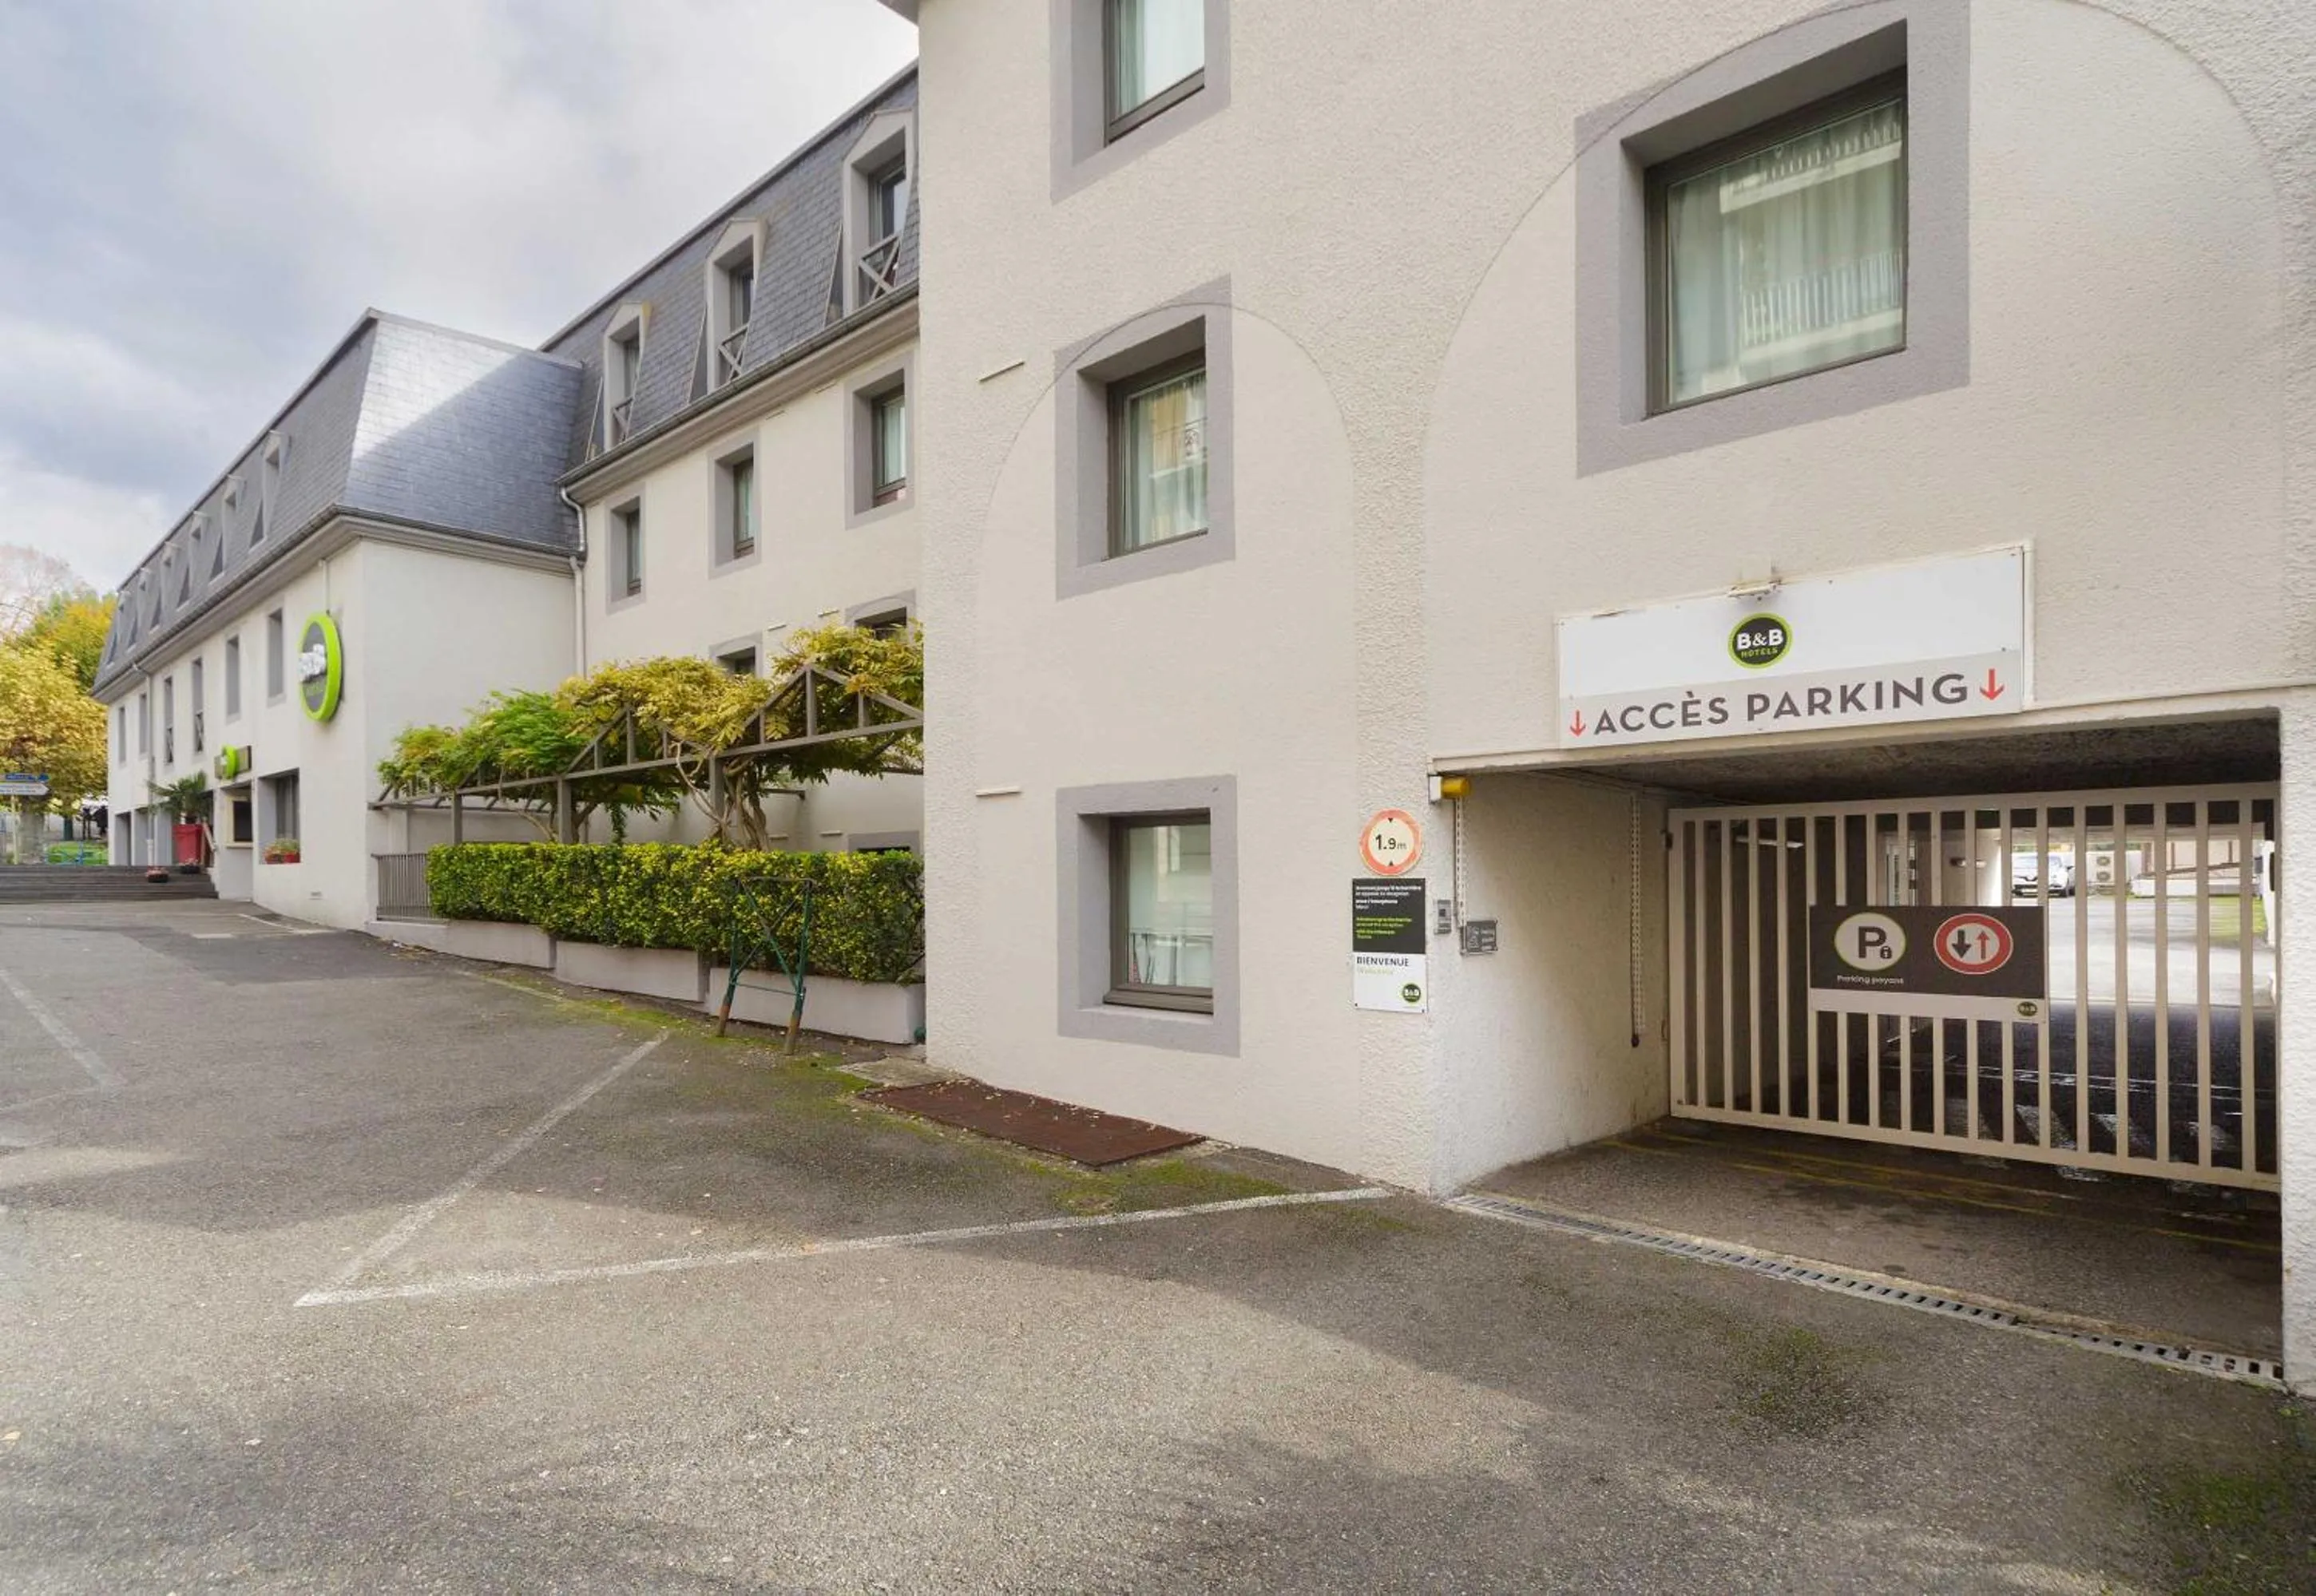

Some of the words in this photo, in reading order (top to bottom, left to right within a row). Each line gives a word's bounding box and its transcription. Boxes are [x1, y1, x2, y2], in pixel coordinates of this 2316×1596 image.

[1736, 628, 1784, 651] B&B
[1741, 647, 1779, 659] HOTELS
[1593, 691, 1729, 735] ACCÈS
[1747, 674, 1968, 722] PARKING
[1858, 926, 1886, 959] P
[1356, 956, 1410, 967] BIENVENUE
